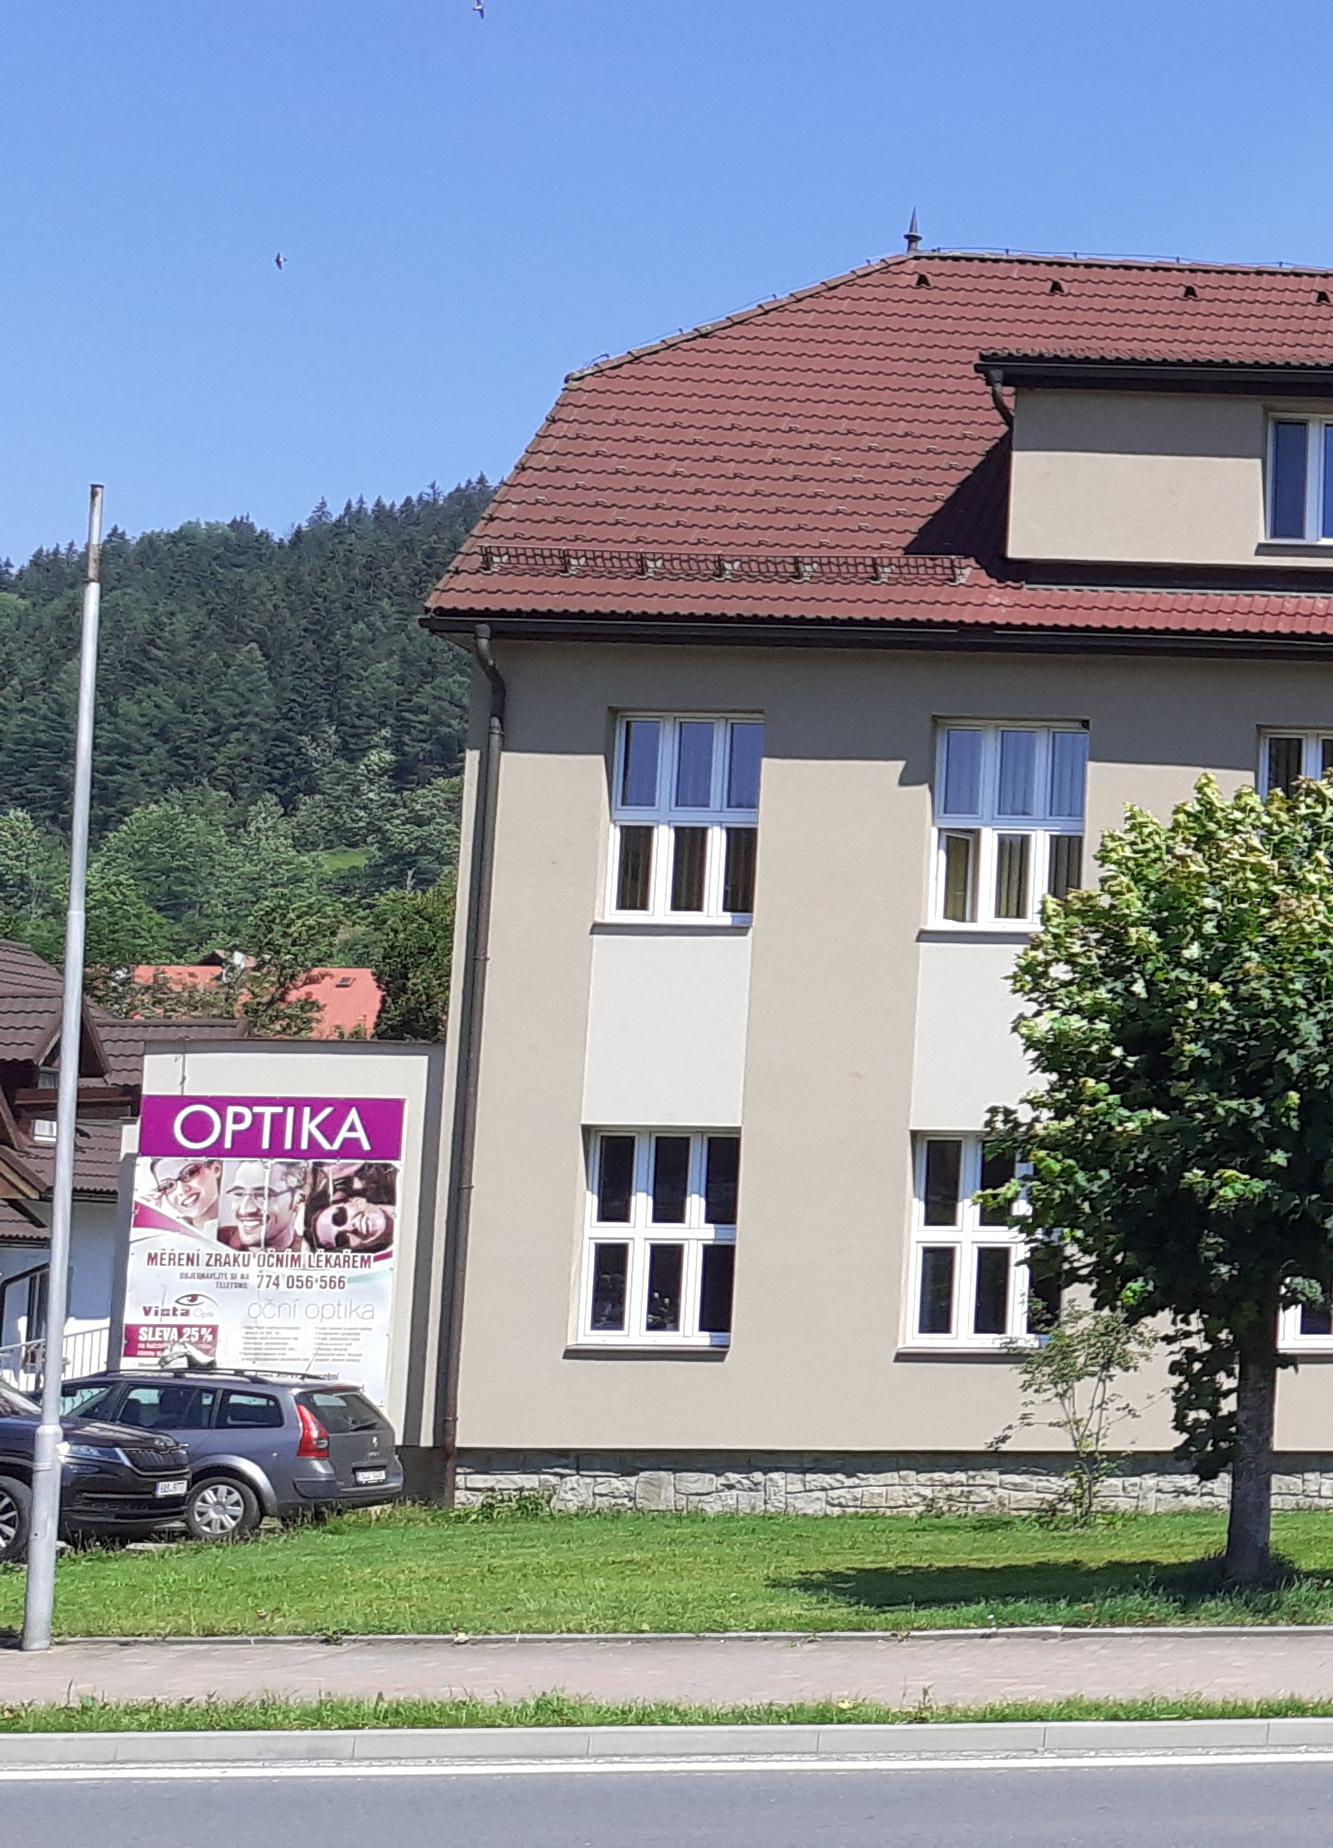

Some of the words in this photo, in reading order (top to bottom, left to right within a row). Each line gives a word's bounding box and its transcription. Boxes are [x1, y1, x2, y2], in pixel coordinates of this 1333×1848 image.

[173, 1104, 371, 1151] OPTIKA
[146, 1248, 200, 1267] MĚŘENÍ
[205, 1252, 251, 1267] ZRAKU
[256, 1250, 302, 1268] OČNÍM
[307, 1250, 372, 1269] LÉKAŘEM
[256, 1275, 280, 1289] 774
[286, 1275, 313, 1290] 056
[319, 1275, 346, 1290] 566
[247, 1298, 300, 1320] oční
[304, 1299, 375, 1322] optika
[138, 1327, 178, 1341] SLEVA
